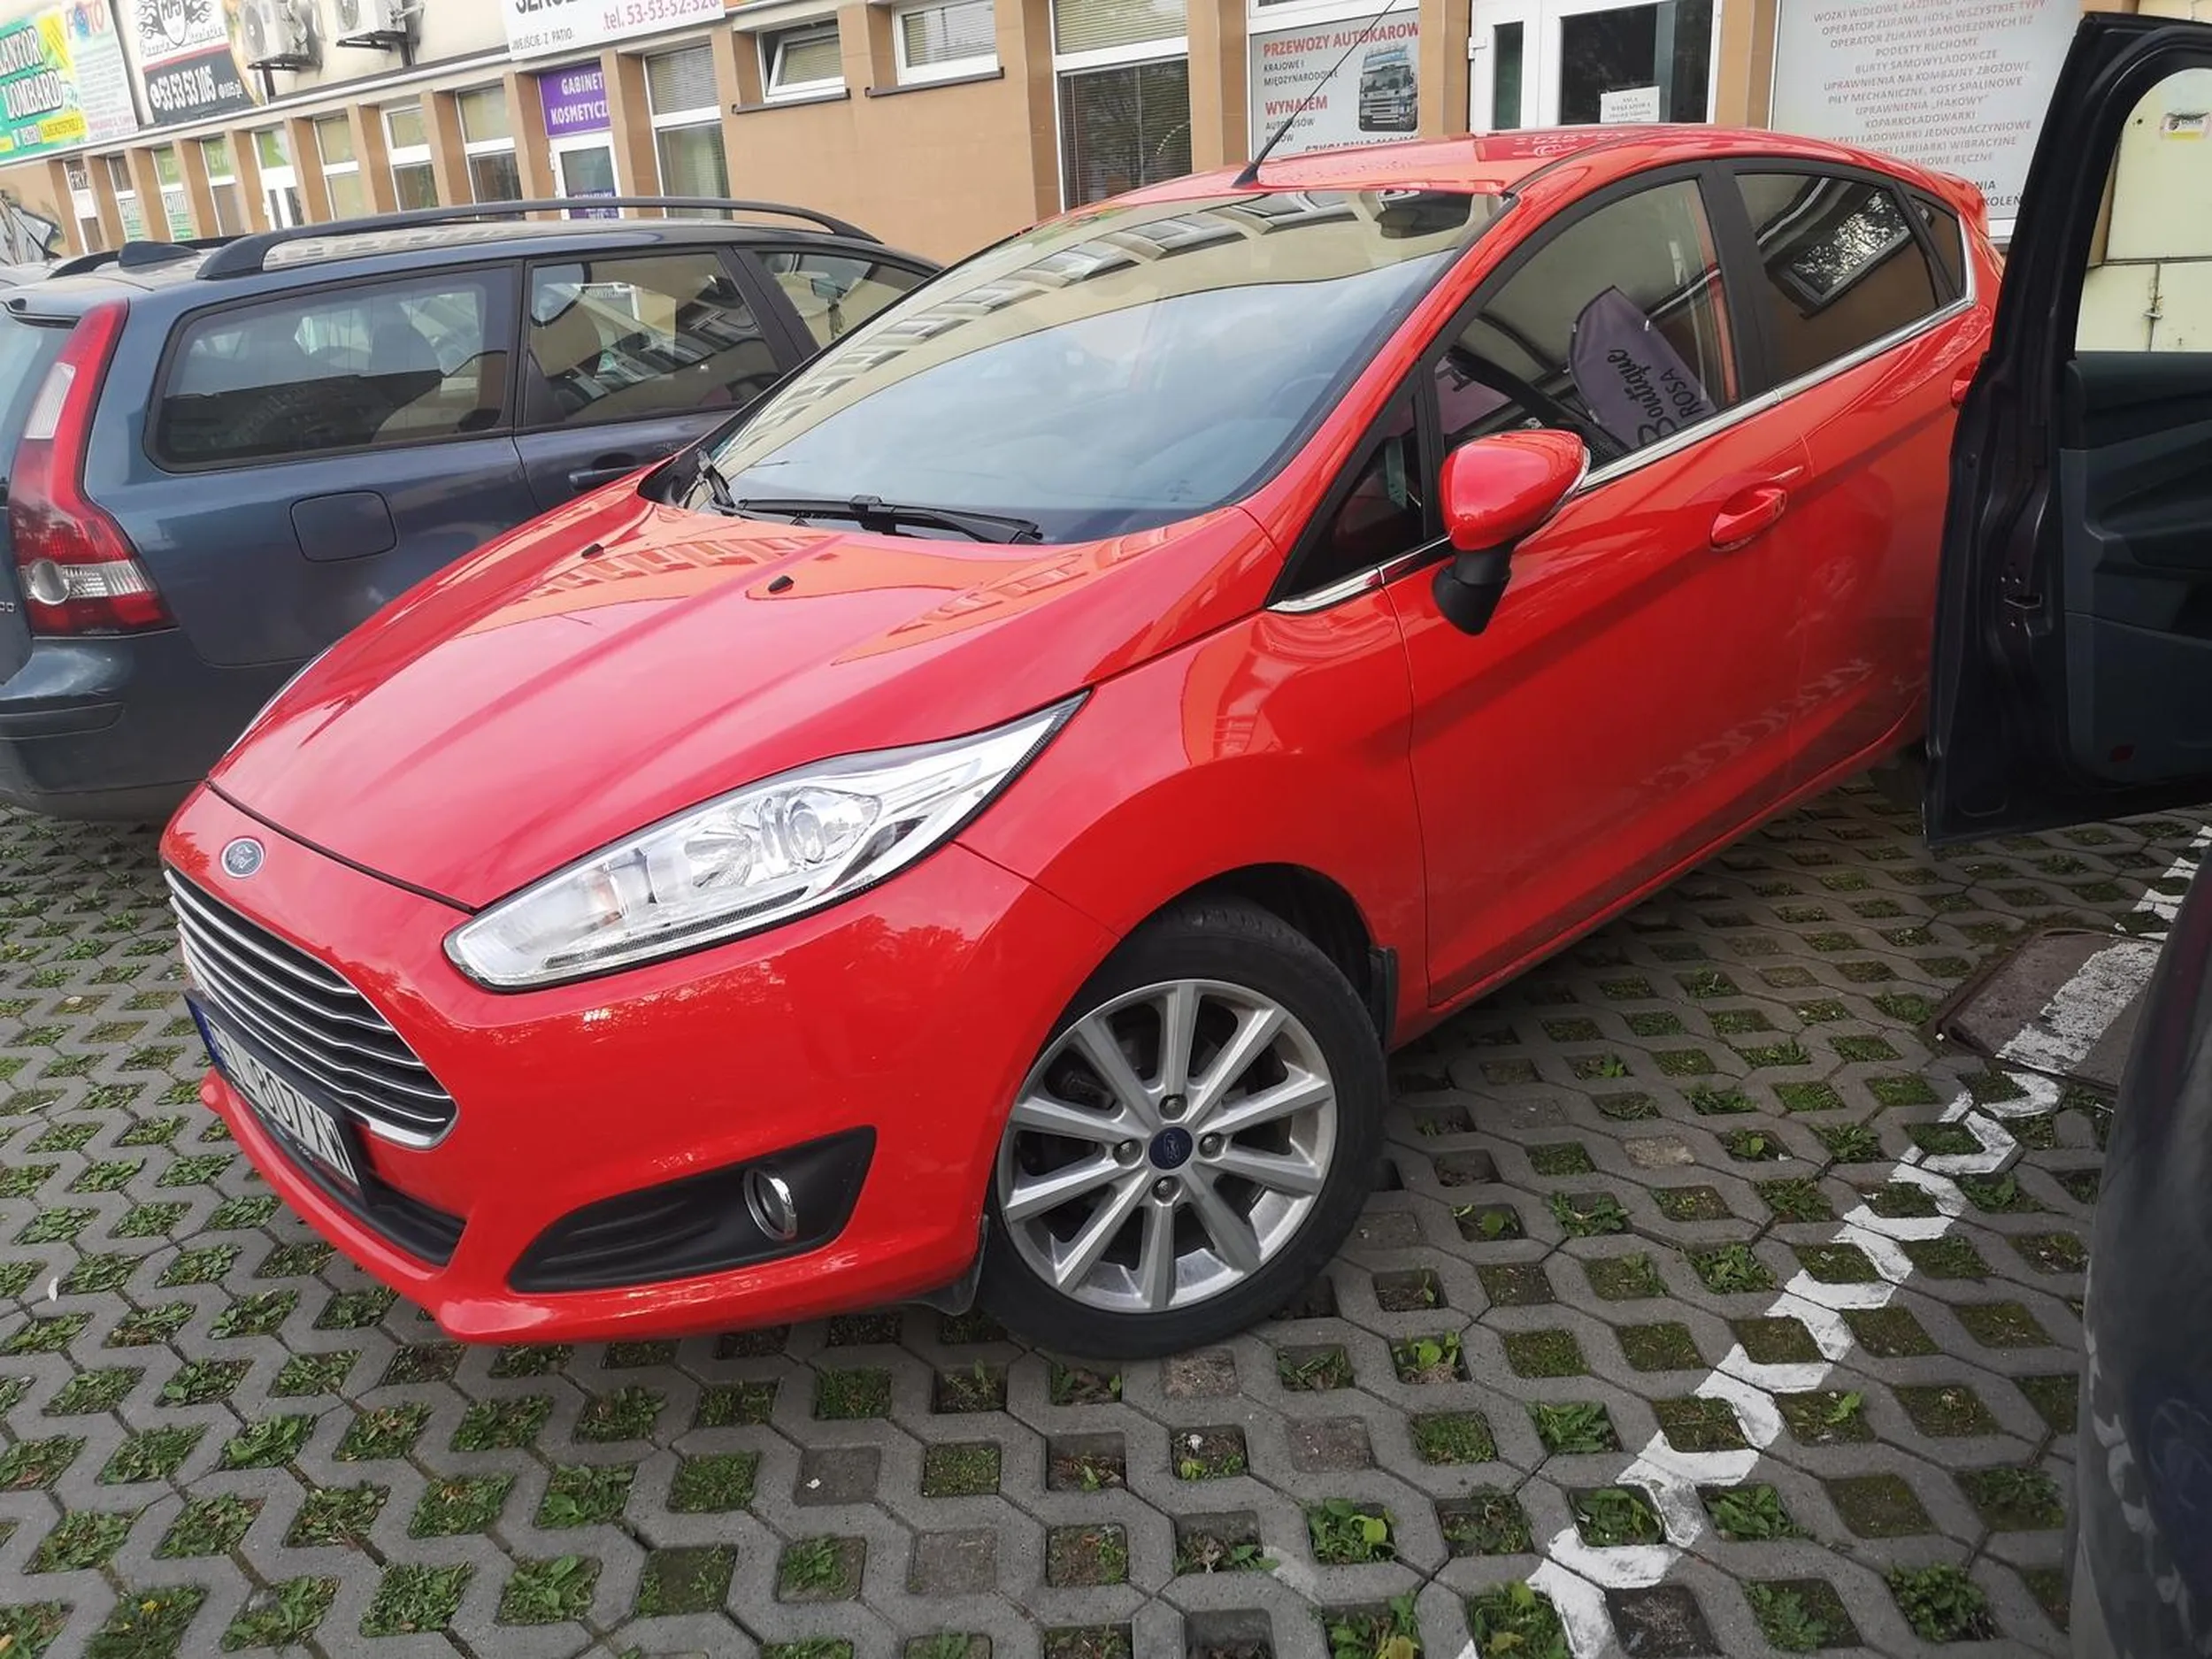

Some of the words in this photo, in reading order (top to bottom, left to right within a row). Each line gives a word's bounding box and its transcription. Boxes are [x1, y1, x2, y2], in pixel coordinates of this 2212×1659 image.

[1822, 21, 1874, 35] OPERATOR
[1955, 3, 2016, 18] WSZYSTKIE
[543, 32, 549, 44] Z
[1263, 34, 1331, 58] PRZEWOZY
[1831, 35, 1883, 49] OPERATOR
[1876, 44, 1921, 57] PODESTY
[1924, 37, 1978, 51] RUCHOME
[1263, 60, 1300, 72] KRAJOWE
[1855, 62, 1888, 74] BURTY
[562, 72, 604, 96] GABINET
[1824, 75, 1896, 91] UPRAWNIENIA
[1897, 73, 1913, 83] NA
[1916, 67, 1975, 81] KOMBAJNY
[1930, 83, 1957, 95] KOSY
[1958, 76, 2024, 91] SPALINOWE
[2, 69, 64, 121] LOMBARD
[1265, 95, 1328, 116] WYNAJEM
[1855, 101, 1929, 116] UPRAWNIENIA
[1924, 119, 2032, 138] JEDNONACZYNIOWE
[1949, 137, 2017, 150] WIBRACYJNE
[1607, 349, 1678, 442] Boutique
[1659, 366, 1705, 419] ROSA
